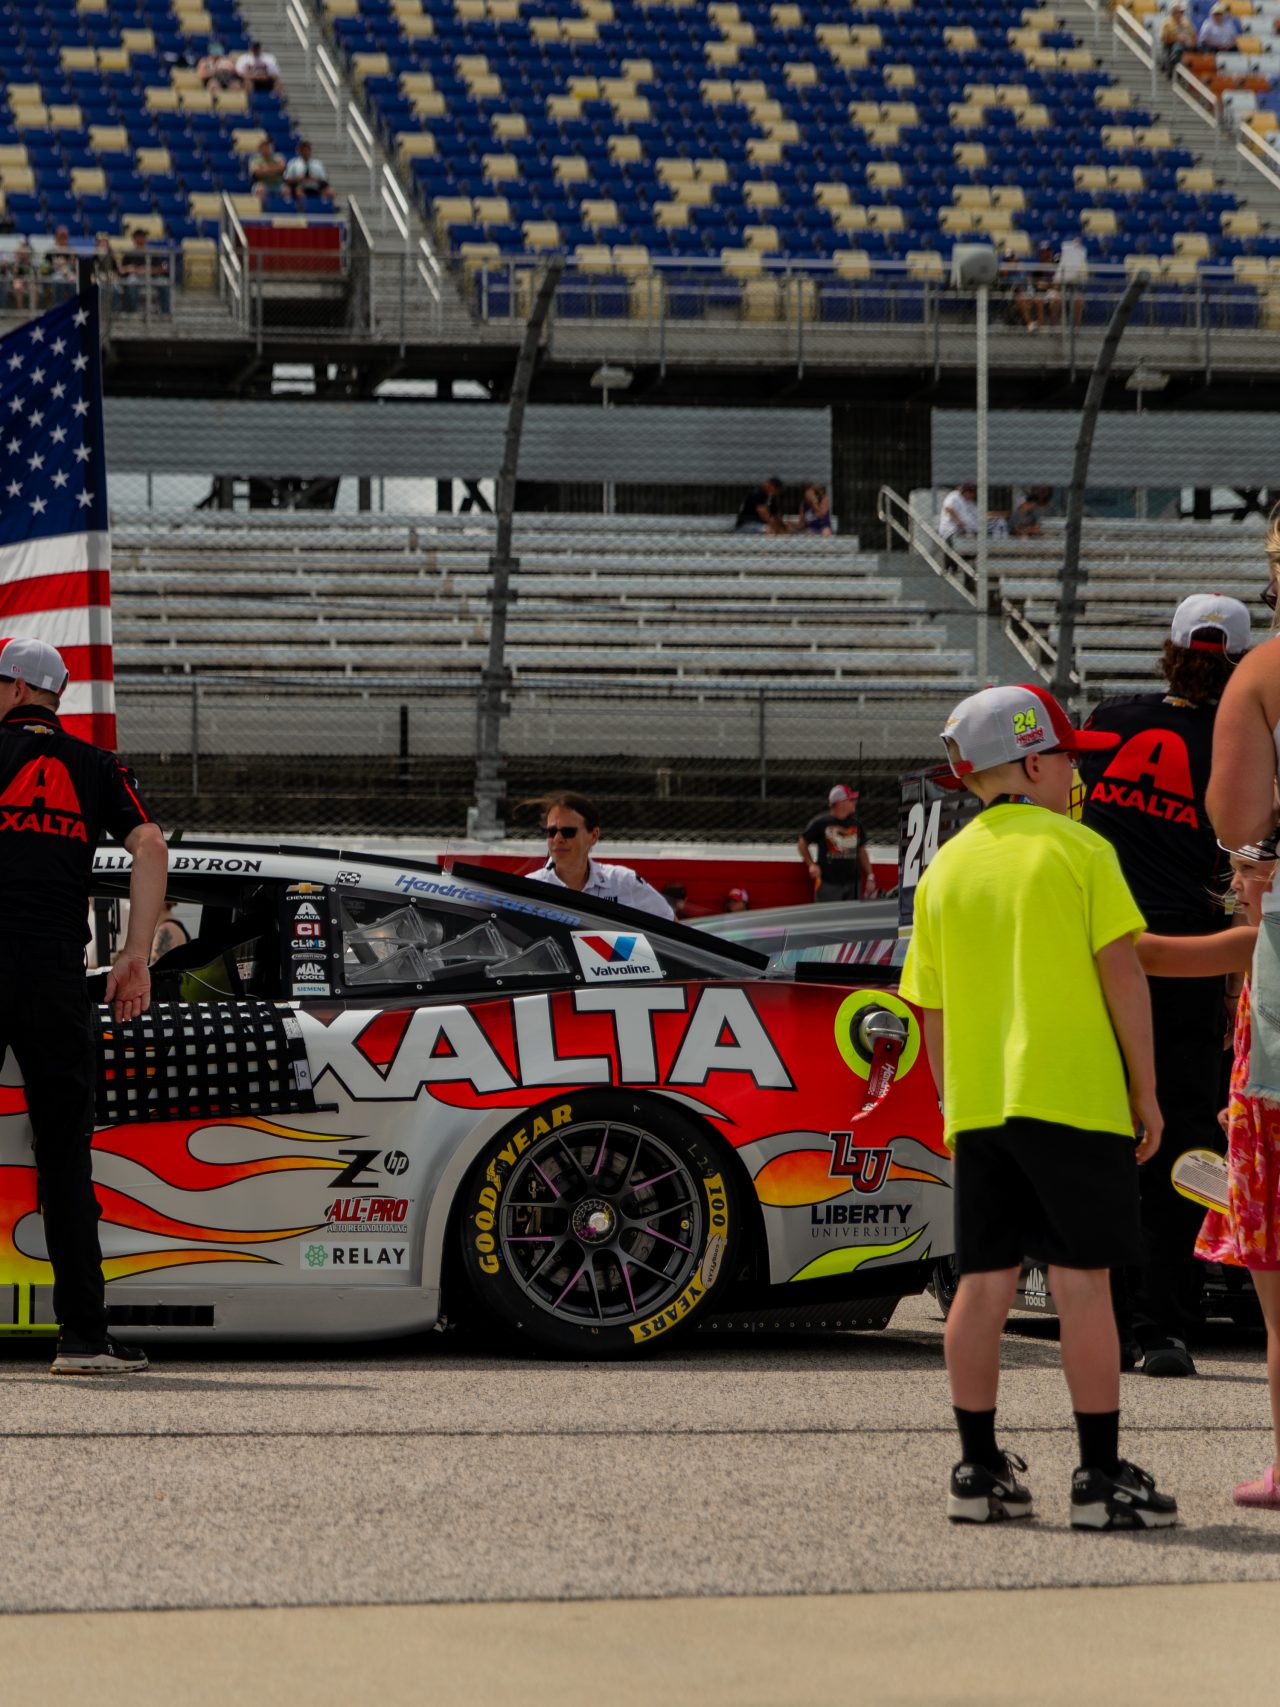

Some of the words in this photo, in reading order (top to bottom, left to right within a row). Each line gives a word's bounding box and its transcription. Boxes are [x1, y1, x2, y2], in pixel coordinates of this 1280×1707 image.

[1013, 708, 1037, 736] 24
[1090, 782, 1199, 829] AXALTA
[902, 799, 942, 888] 24
[173, 857, 263, 873] BYRON
[296, 962, 325, 976] MAC
[590, 964, 652, 977] Valvoline
[327, 1149, 383, 1188] Z
[384, 1150, 410, 1177] hp
[829, 1130, 894, 1195] LU
[475, 1104, 574, 1274] GOODYEAR
[326, 1198, 409, 1222] ALL-PRO
[709, 1184, 726, 1228] 100
[811, 1204, 913, 1225] LIBERTY
[327, 1224, 347, 1233] AUTO
[348, 1224, 408, 1233] RECONDITIONING
[811, 1226, 911, 1239] UNIVERSITY
[332, 1247, 406, 1265] RELAY
[638, 1285, 702, 1338] YEARS
[1024, 1295, 1047, 1308] TOOLS
